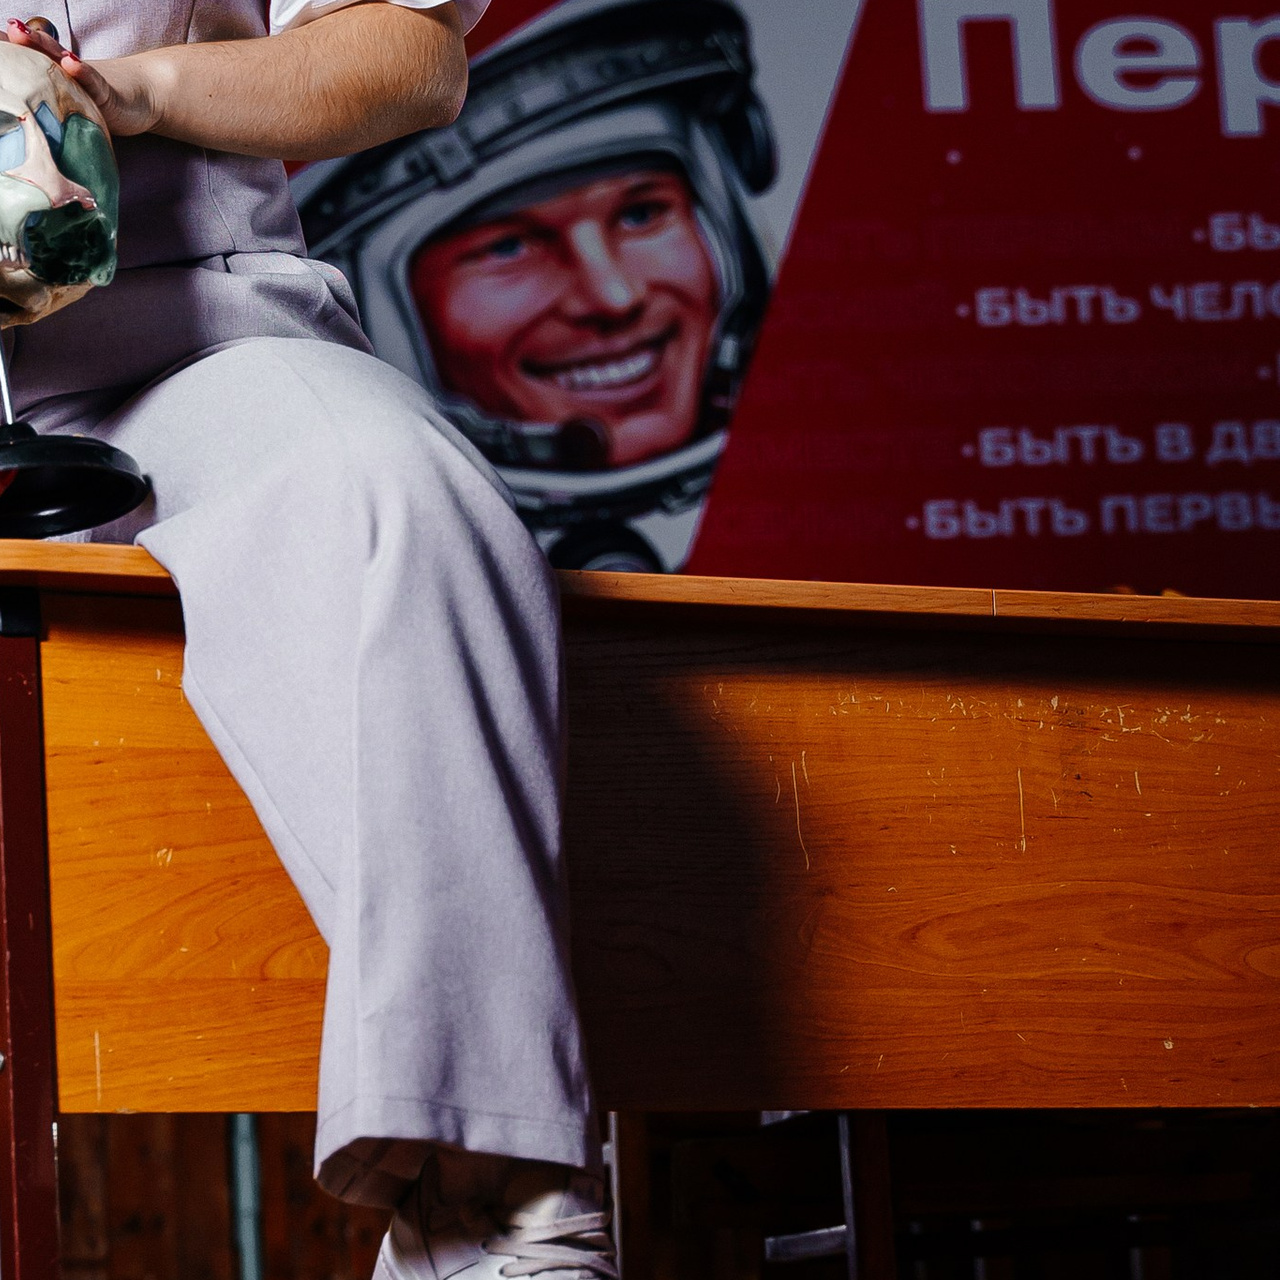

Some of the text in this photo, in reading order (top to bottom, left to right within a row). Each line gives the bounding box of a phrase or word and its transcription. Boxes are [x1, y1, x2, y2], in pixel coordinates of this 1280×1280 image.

[974, 285, 1141, 327] БЫТЬ
[978, 424, 1144, 467] БЫТЬ
[1154, 422, 1194, 462] В
[922, 497, 1089, 540] БЫТЬ
